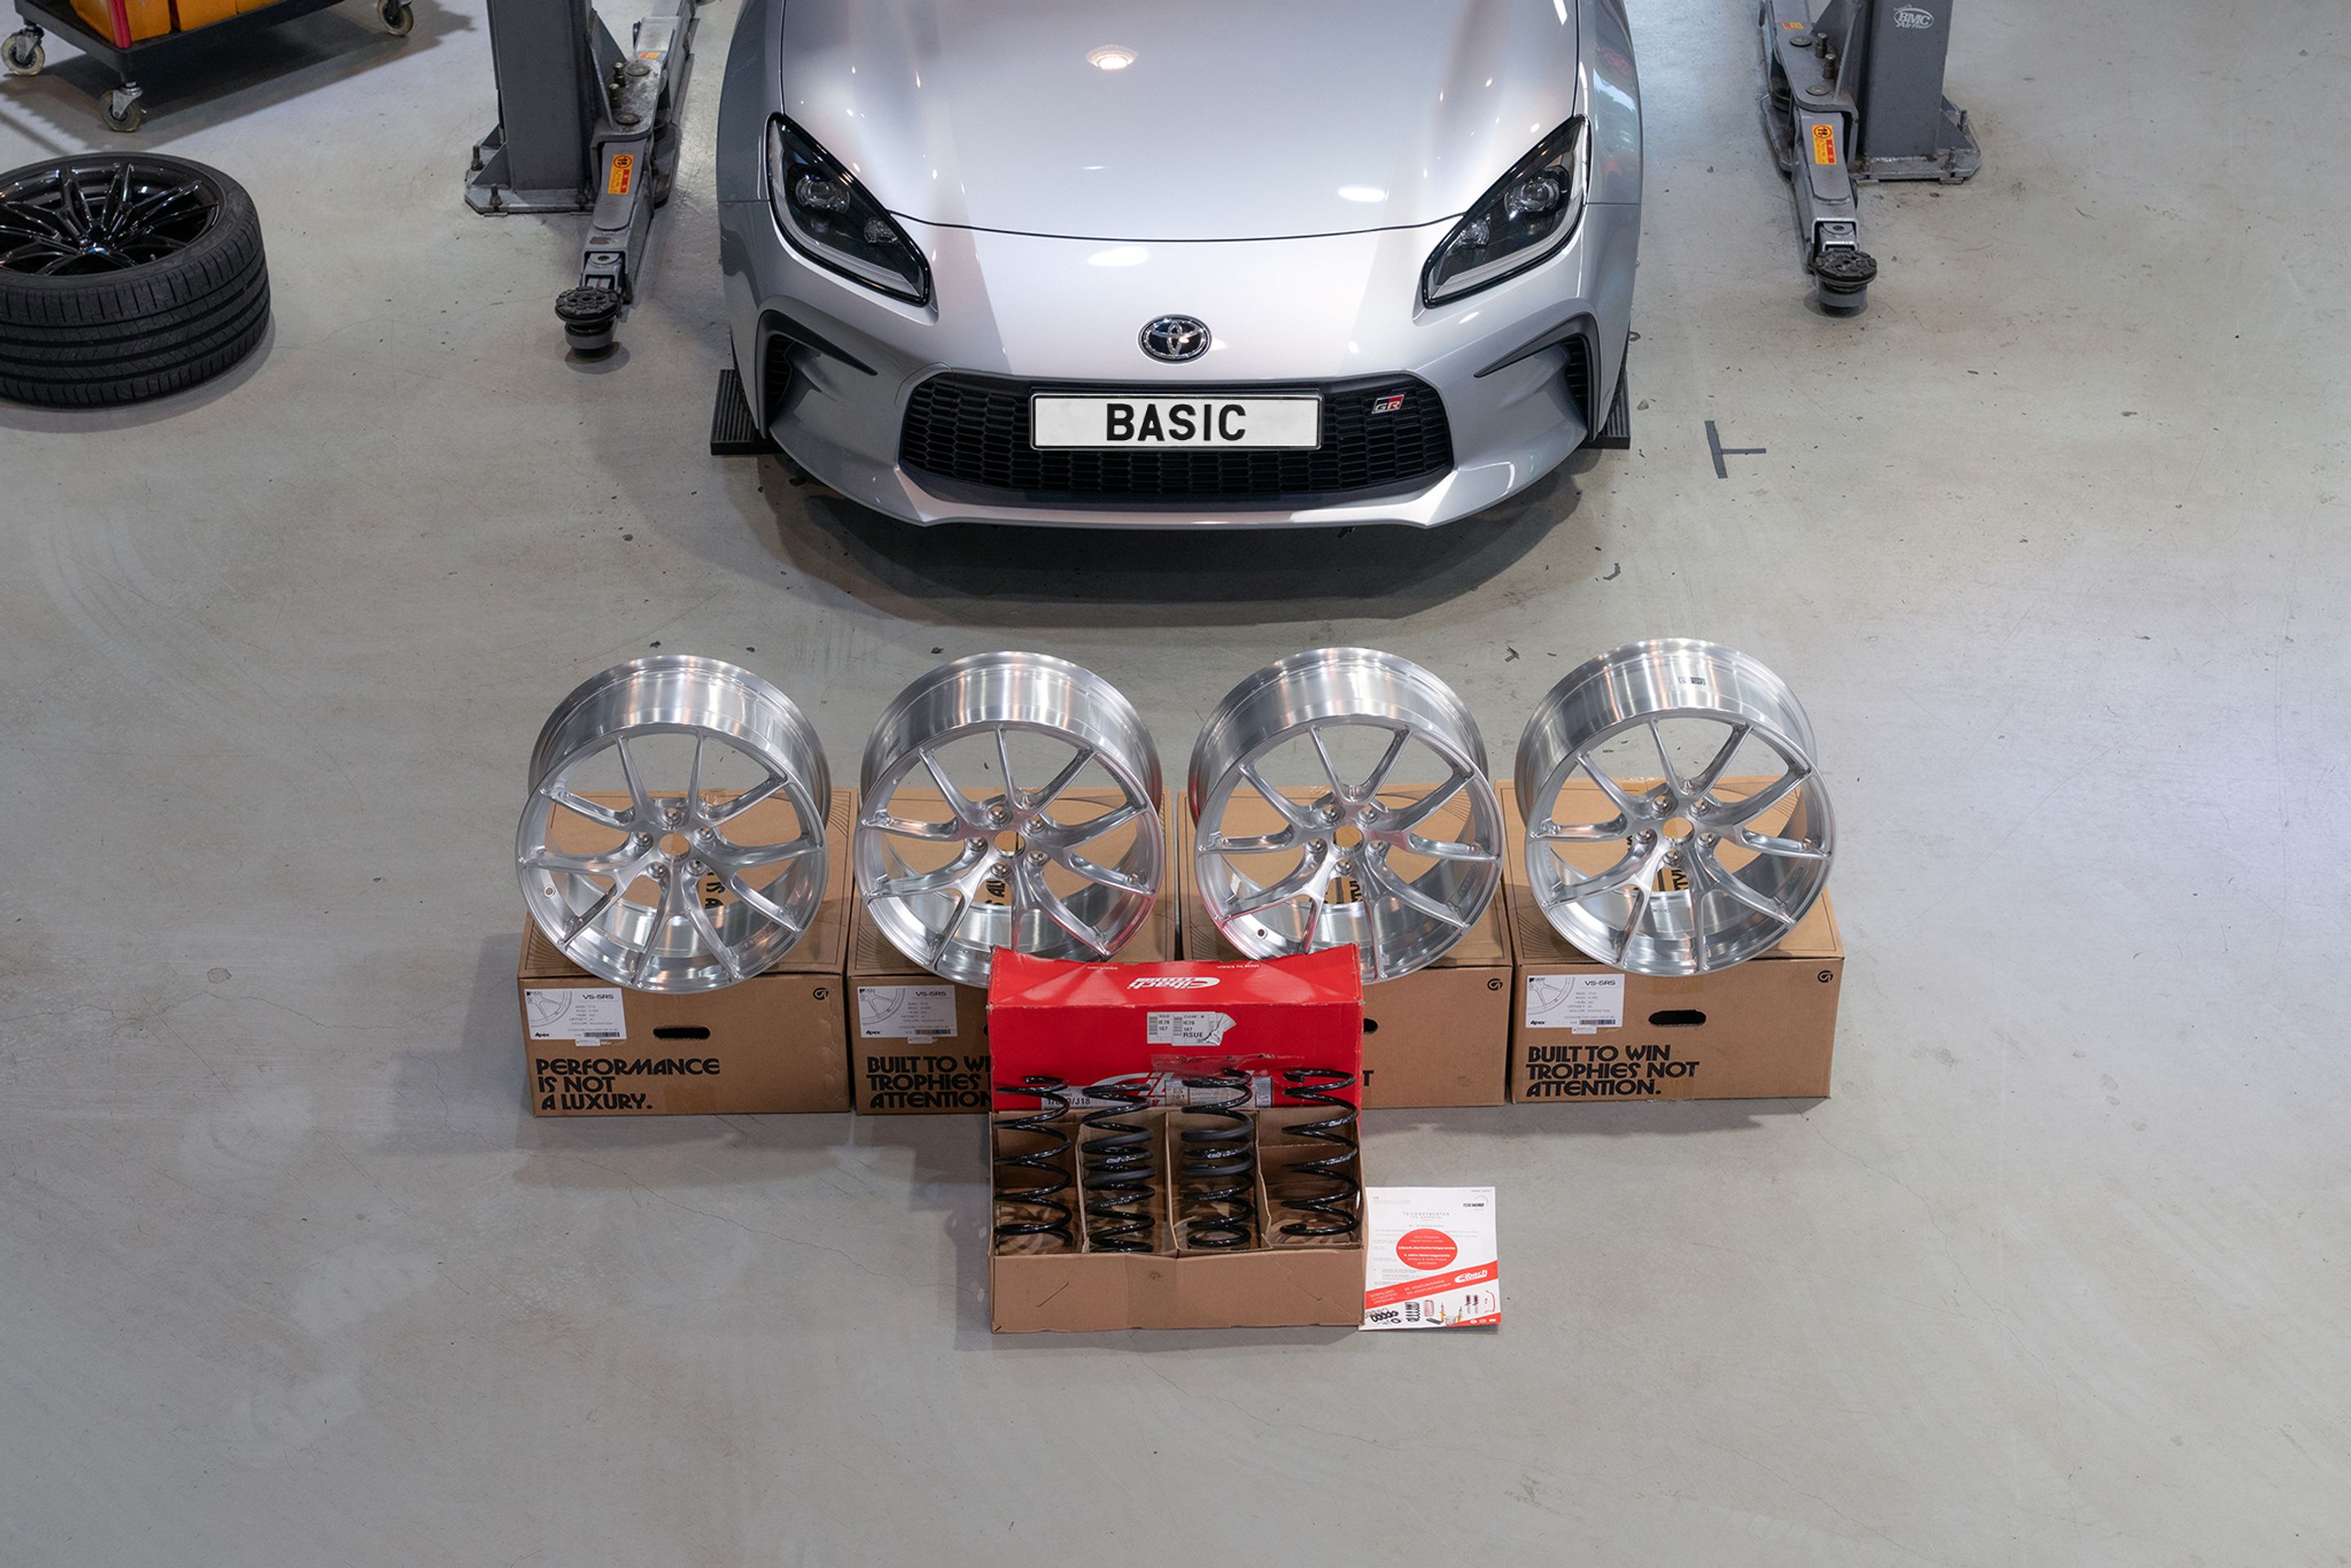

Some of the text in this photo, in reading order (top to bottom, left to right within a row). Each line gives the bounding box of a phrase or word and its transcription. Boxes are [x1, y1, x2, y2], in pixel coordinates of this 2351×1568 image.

[1897, 12, 1931, 25] BMC
[1106, 402, 1246, 442] BASIC
[1528, 1045, 1670, 1062] BUILT TO WIN
[536, 1058, 720, 1075] PERFORMANCE
[867, 1055, 991, 1073] BUILT TO WI
[1526, 1061, 1700, 1080] TROPHIES NOT
[538, 1076, 616, 1093] IS NOT
[866, 1073, 982, 1091] TROPHIES
[1526, 1079, 1662, 1097] ATTENTION.
[541, 1093, 653, 1110] A LUXURY.
